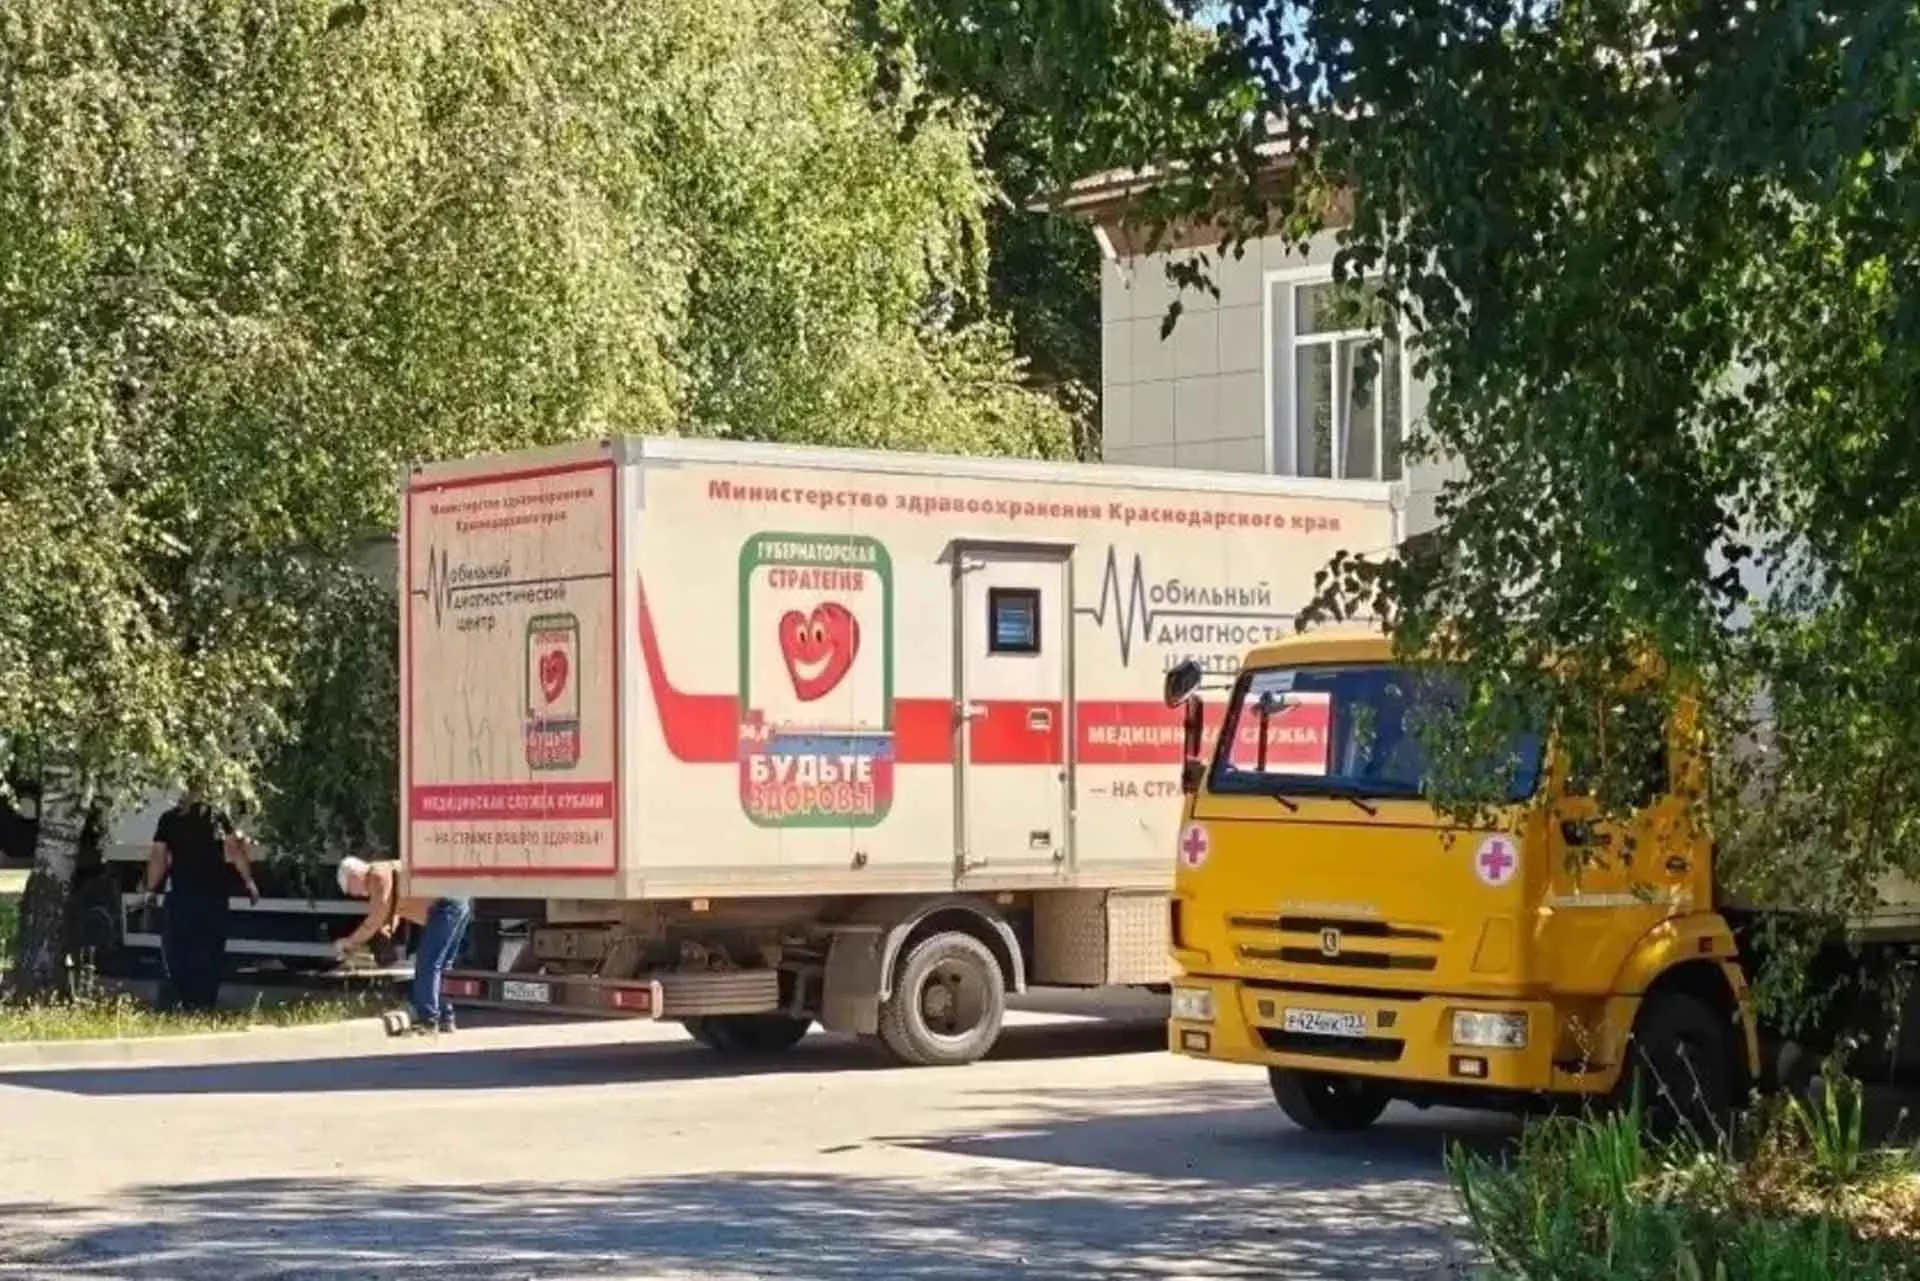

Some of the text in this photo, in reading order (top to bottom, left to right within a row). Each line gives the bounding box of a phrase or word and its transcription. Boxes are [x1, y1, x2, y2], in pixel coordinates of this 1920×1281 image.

[707, 479, 1341, 535] Министерство здравоохранения Краснодарского края
[757, 541, 876, 563] ГУБЕРНАТОРСКАЯ
[767, 567, 864, 591] СТРАТЕГИЯ
[750, 754, 873, 784] БУДЬТЕ
[750, 783, 875, 817] ЗДОРОВЫ
[1111, 780, 1182, 798] НА СТР
